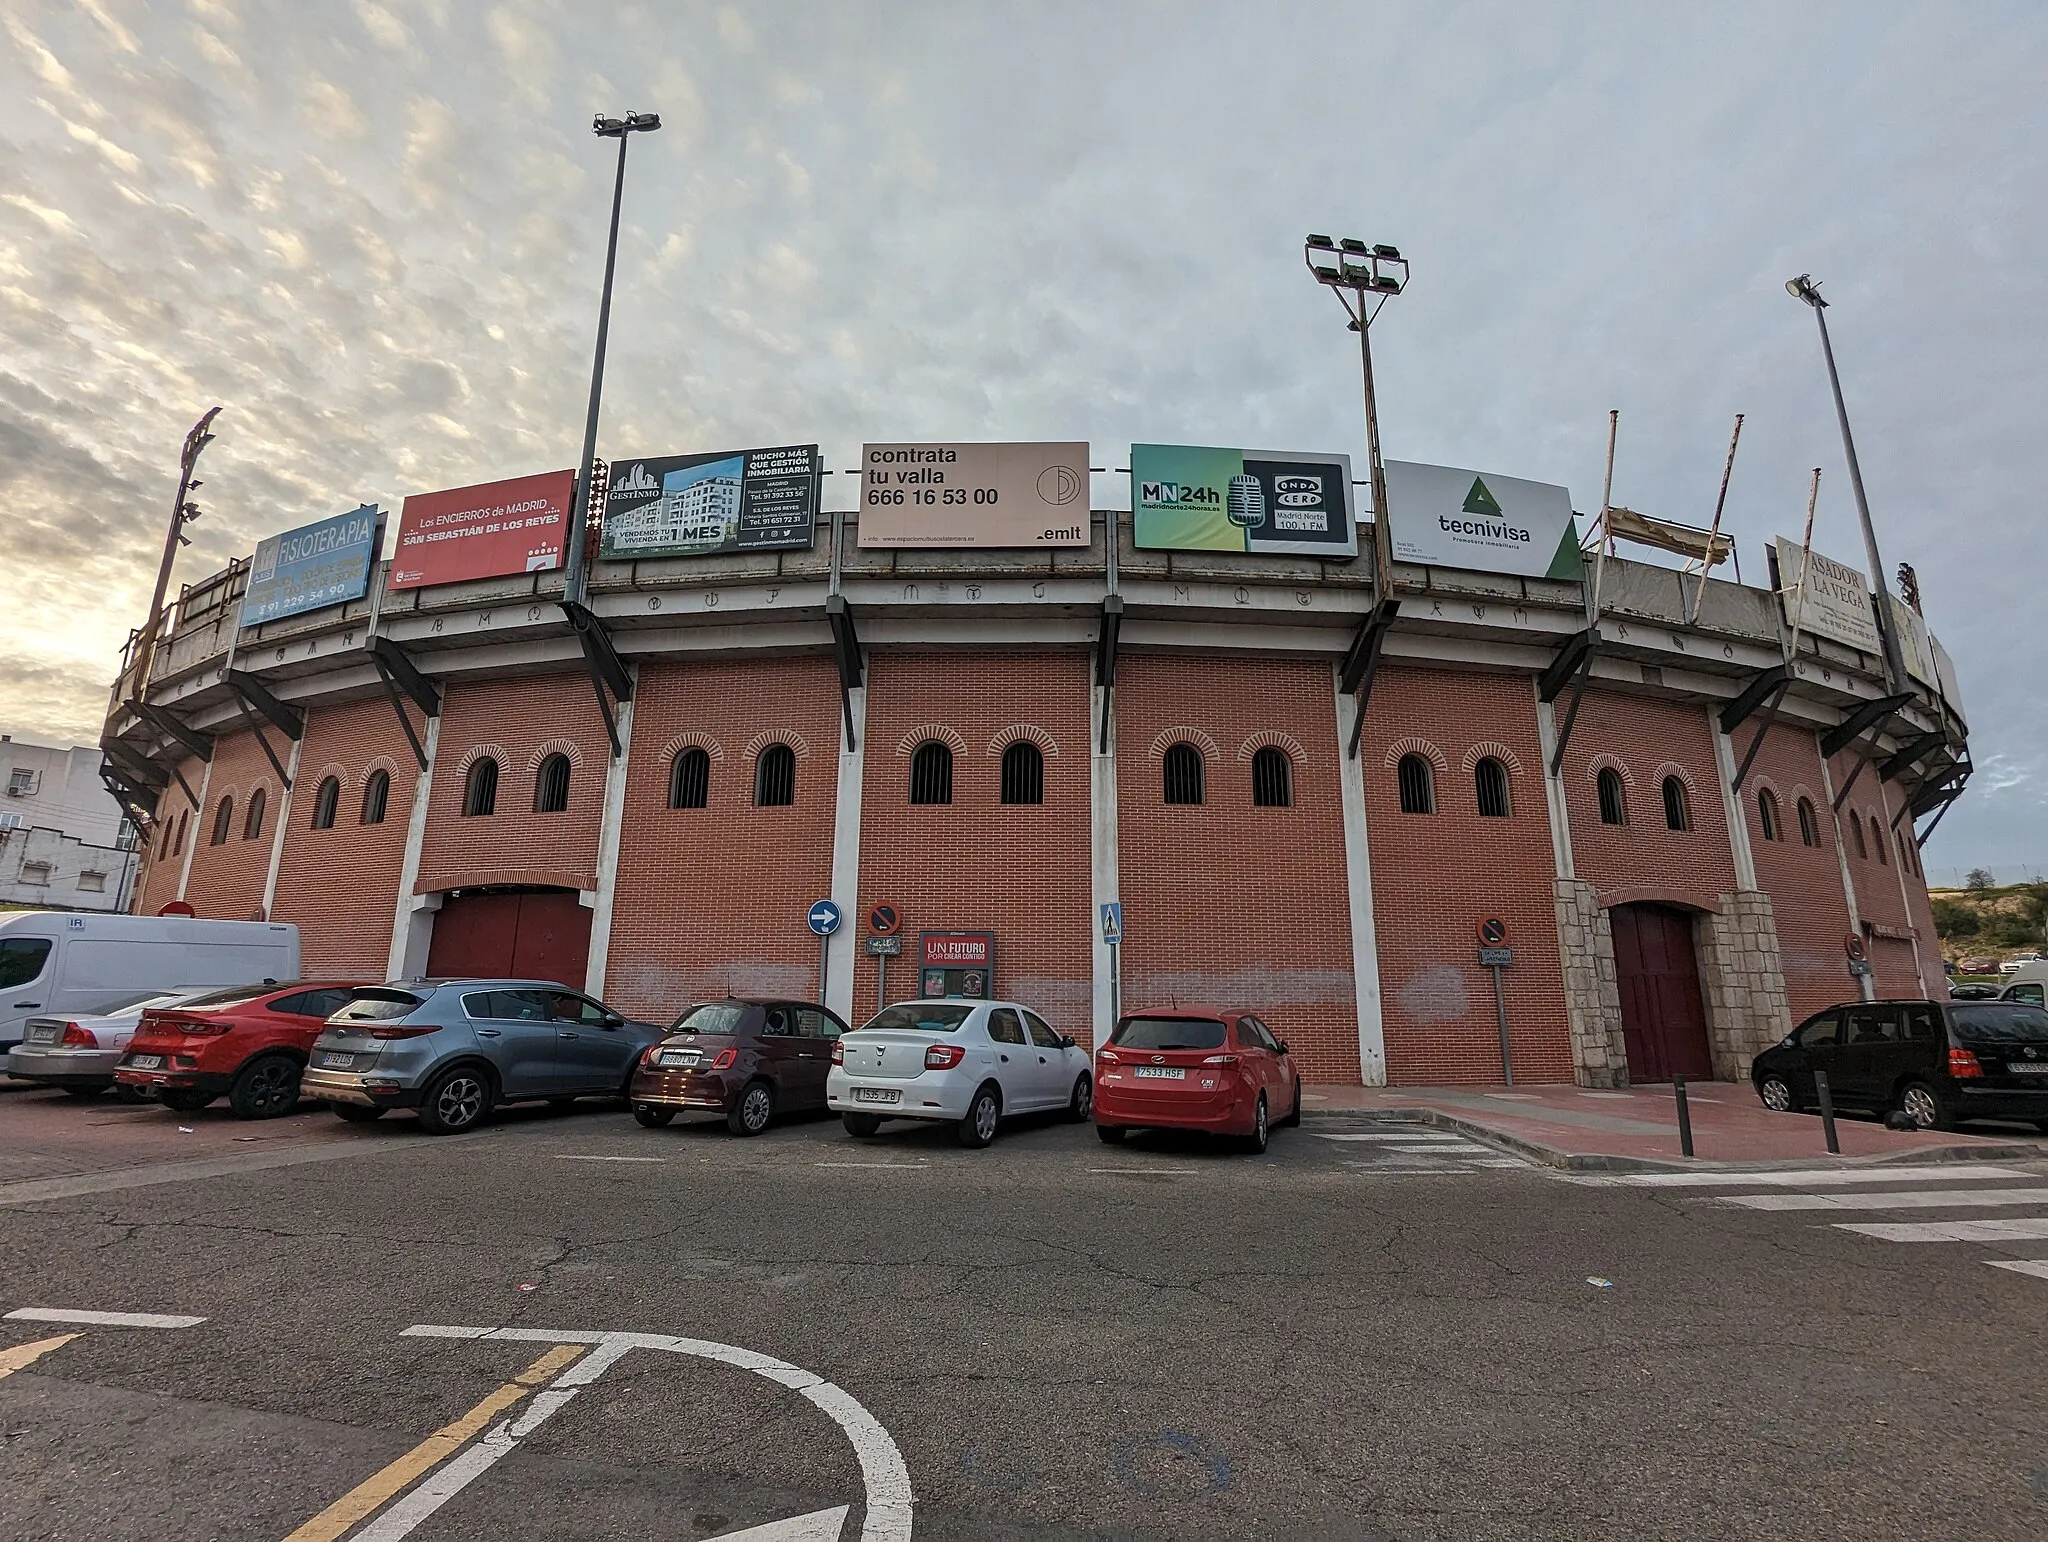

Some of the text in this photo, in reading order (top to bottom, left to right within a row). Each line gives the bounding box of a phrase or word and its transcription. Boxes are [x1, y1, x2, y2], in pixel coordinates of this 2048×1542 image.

[752, 449, 808, 460] MUCHO MÁS
[870, 448, 957, 463] contrata
[750, 457, 809, 470] QUE GESTIÓN
[747, 466, 810, 477] INMOBILIARIA
[869, 468, 945, 484] tu valla
[1280, 482, 1317, 490] ONDA
[868, 488, 998, 506] 666 16 53 00
[1283, 495, 1317, 504] CERO
[420, 499, 548, 528] Los ENCIERROS de MADRID
[1141, 504, 1220, 512] madridnorte24horas.es
[1276, 512, 1325, 522] Madrid Norte
[403, 514, 560, 546] SAN SEBASTIÁN DE LOS REYES
[1280, 521, 1324, 531] 100.1 FM
[1438, 515, 1530, 542] tecnivisa
[620, 528, 659, 538] VENDEMOS
[671, 526, 720, 540] 1 MES
[278, 517, 369, 565] FISIOTERAPIA
[624, 536, 658, 544] VIVIENDA
[1452, 536, 1484, 545] Promotora
[1811, 555, 1860, 589] ASADOR
[268, 601, 278, 612] 91
[284, 595, 304, 608] 229
[309, 590, 324, 601] 54
[330, 584, 344, 595] 90
[1812, 576, 1866, 610] LA VEGA
[928, 942, 985, 954] UN FUTURO
[1140, 1068, 1182, 1078] 7533 HSF
[863, 1089, 896, 1100] 1535 JFB
